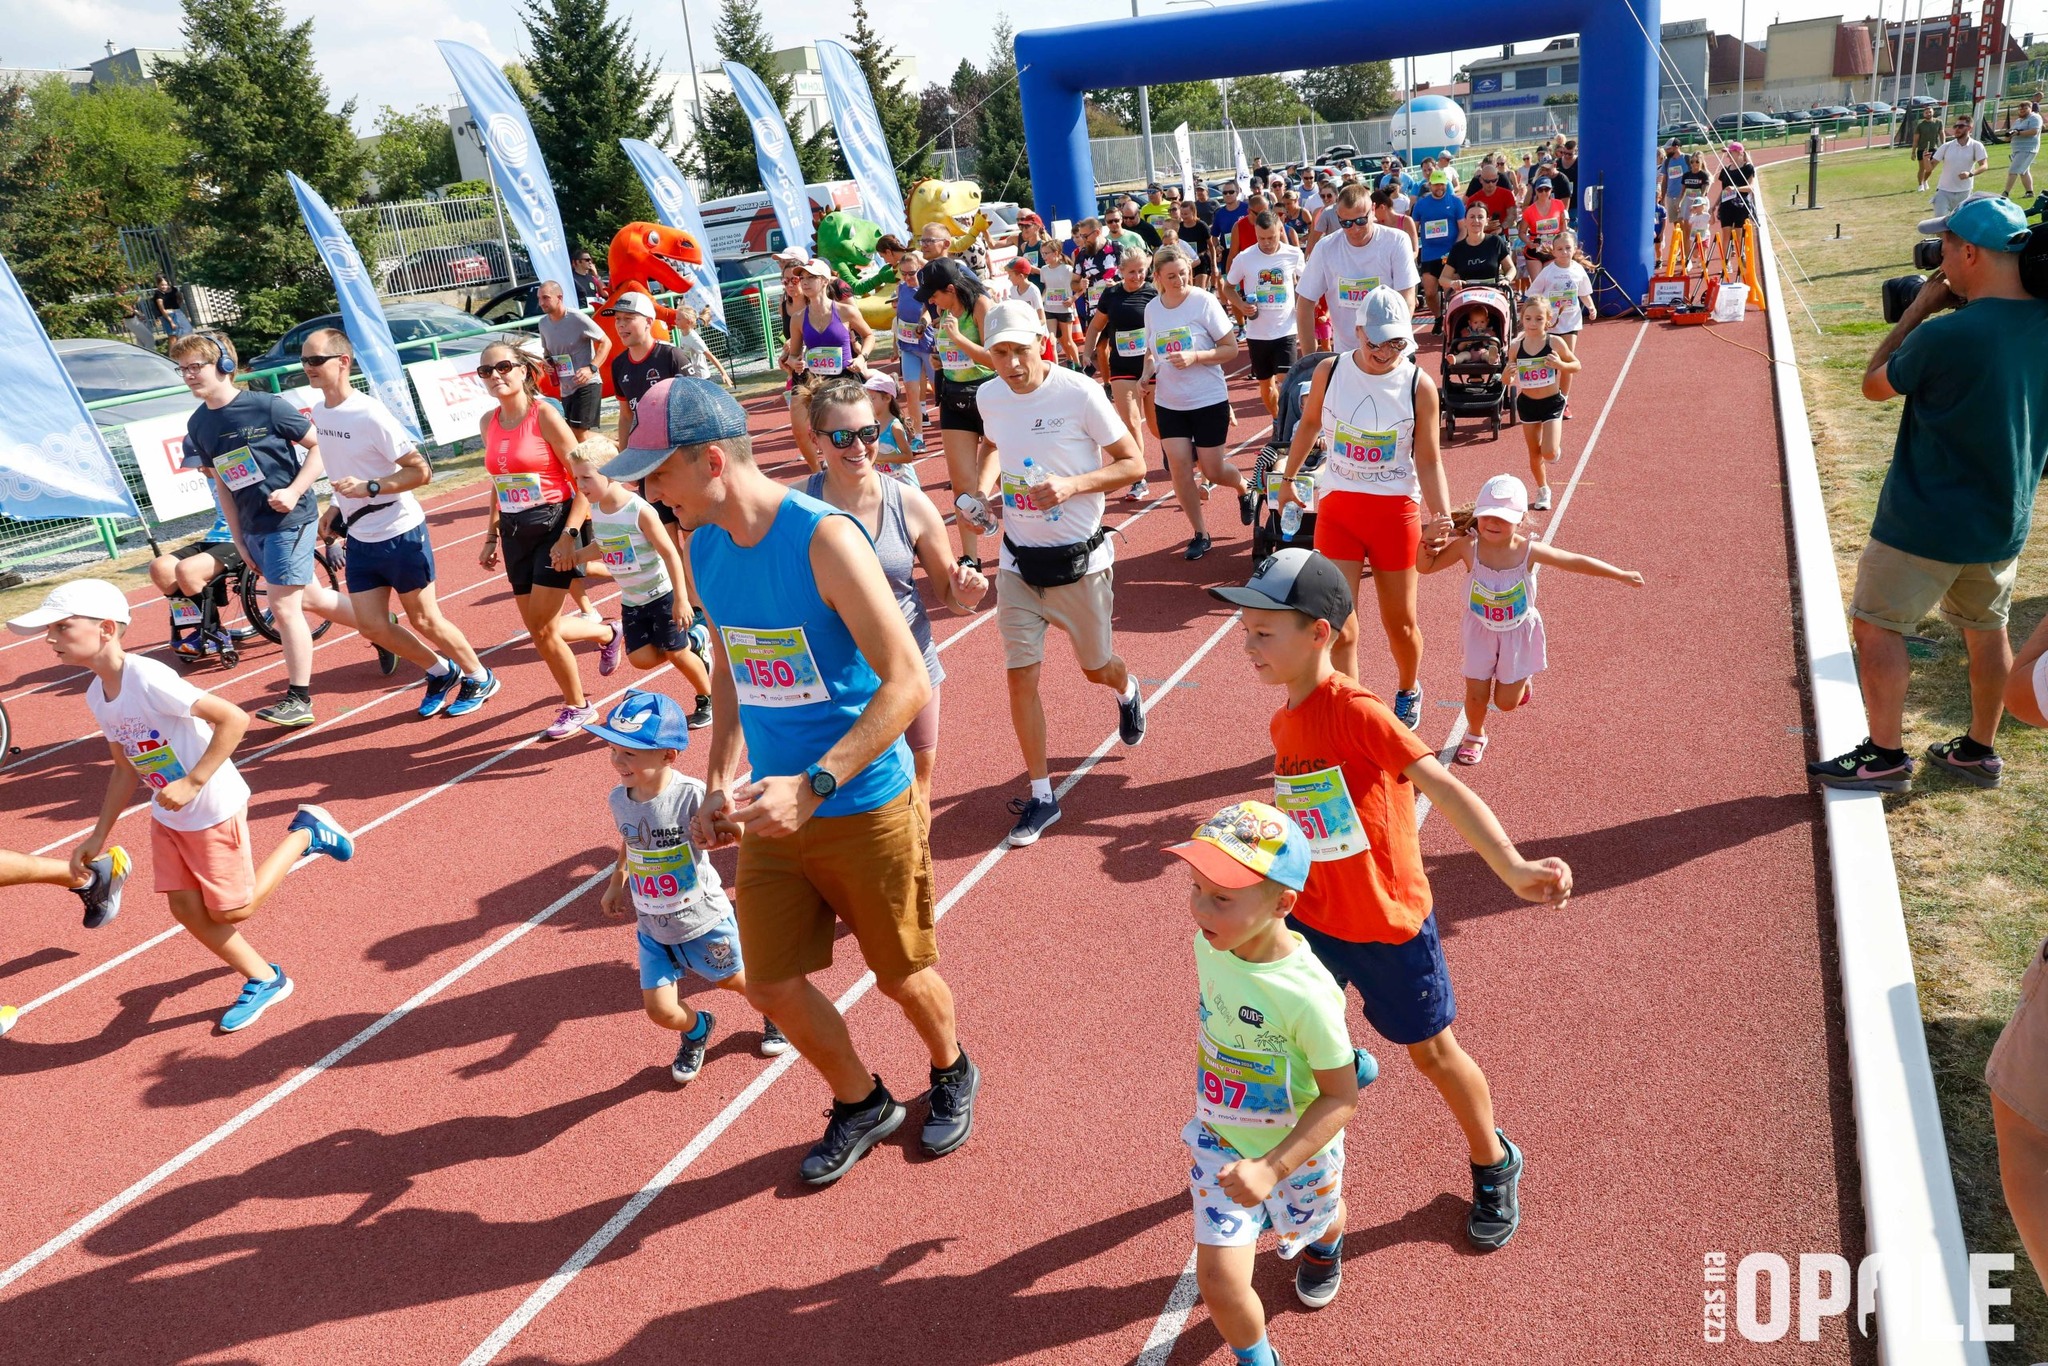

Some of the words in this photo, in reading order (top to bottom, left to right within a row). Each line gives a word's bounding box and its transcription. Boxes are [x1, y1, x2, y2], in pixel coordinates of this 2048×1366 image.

[1393, 128, 1417, 137] OPOE
[775, 162, 800, 228] OPOLE
[517, 172, 555, 256] OPOLE
[1268, 294, 1275, 303] 8
[1129, 340, 1136, 350] 6
[1165, 340, 1182, 353] 40
[812, 357, 835, 368] 346
[946, 351, 958, 363] 67
[1523, 368, 1548, 381] 468
[1345, 441, 1382, 463] 180
[225, 463, 249, 481] 158
[505, 488, 530, 503] 103
[1482, 603, 1513, 622] 181
[744, 658, 795, 688] 150
[651, 826, 684, 838] CHASE
[656, 837, 682, 848] CASE
[633, 872, 678, 898] 149
[1241, 1008, 1264, 1022] DUDE
[1205, 1055, 1225, 1070] FAMILY
[1225, 1066, 1242, 1076] RUN
[1204, 1070, 1247, 1109] 97
